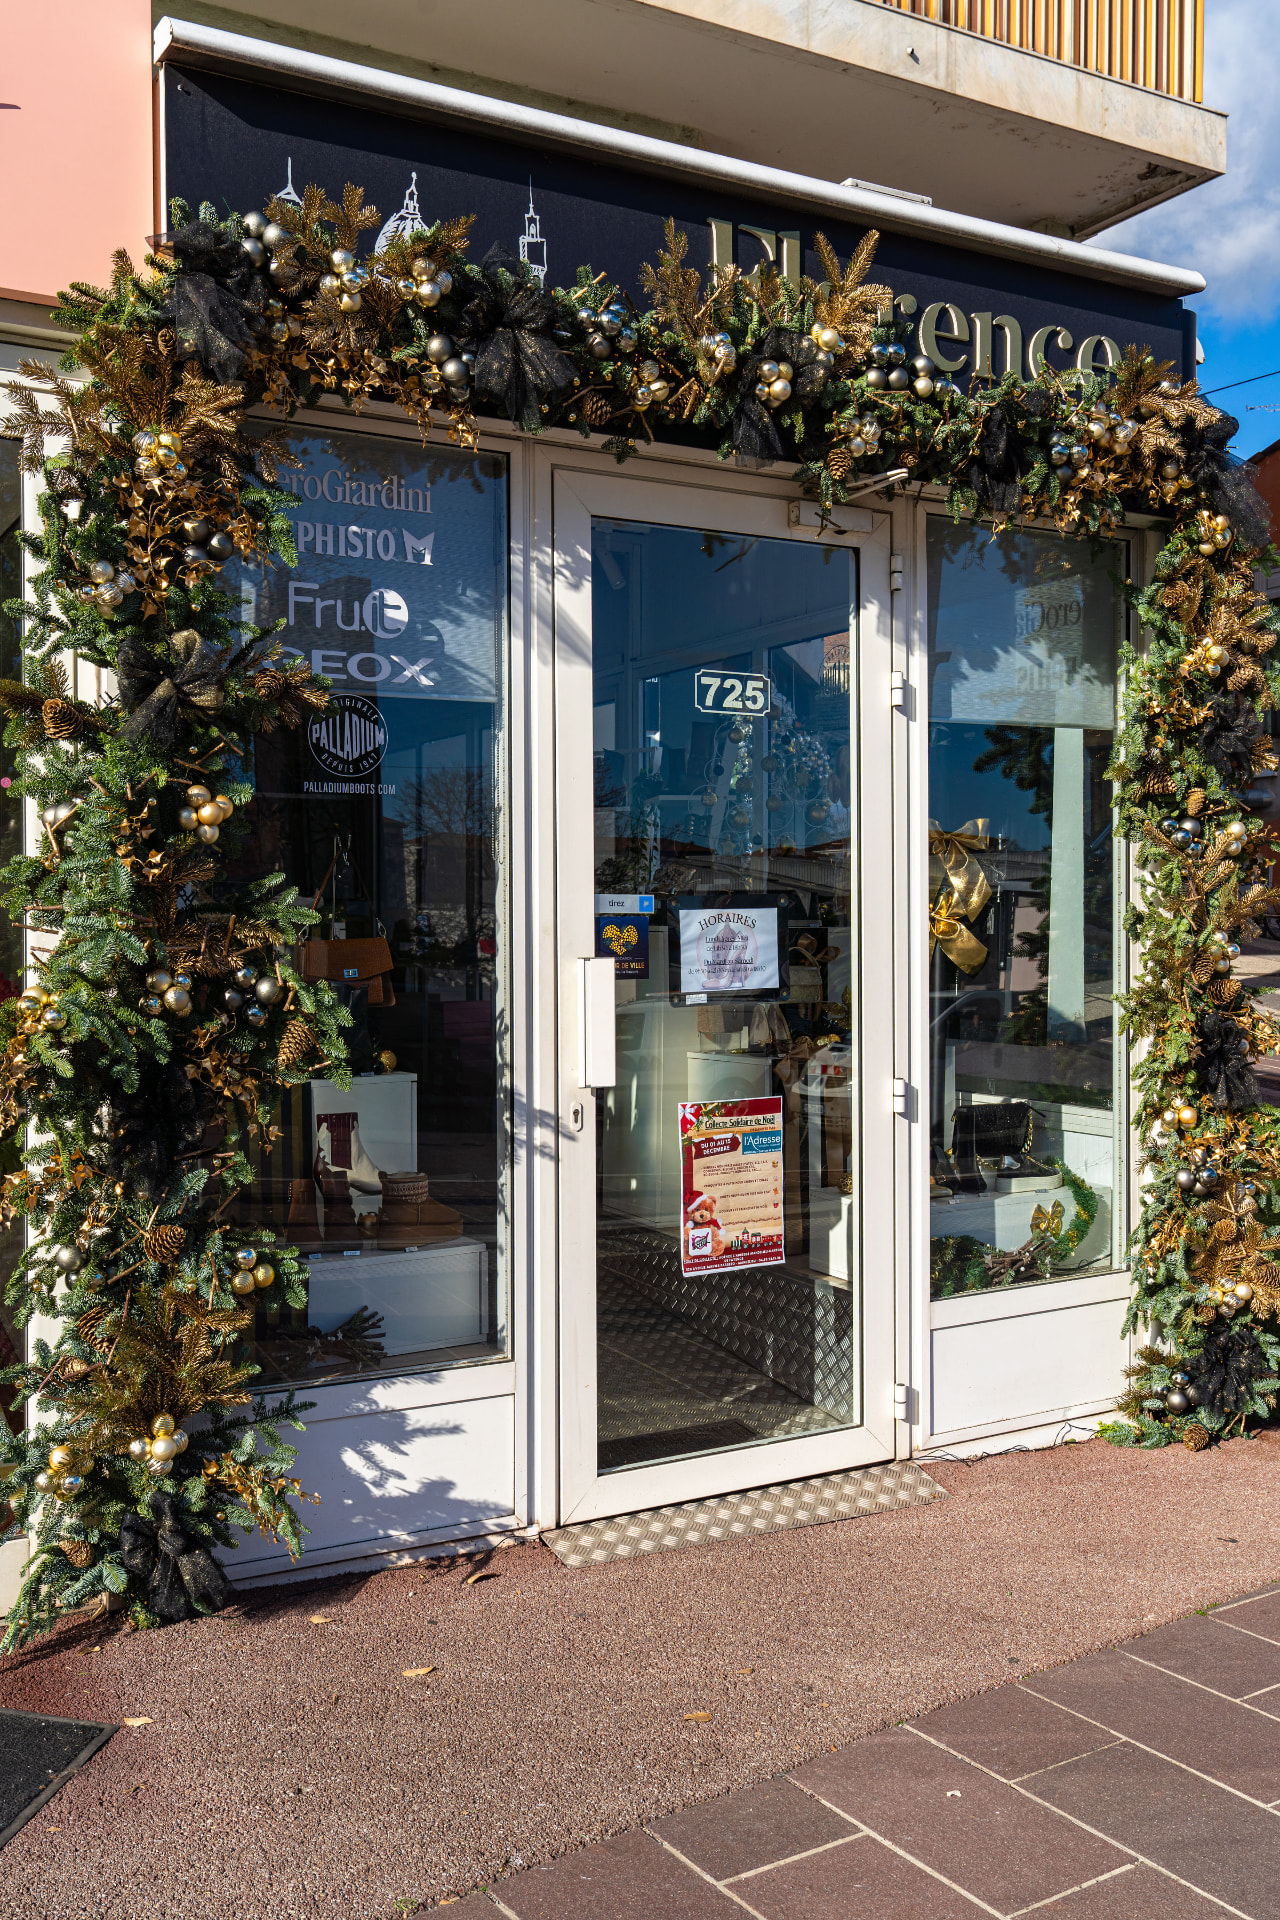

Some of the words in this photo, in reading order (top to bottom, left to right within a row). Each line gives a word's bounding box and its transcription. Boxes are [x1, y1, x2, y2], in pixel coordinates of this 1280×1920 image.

[706, 217, 1122, 386] Flrence
[291, 520, 396, 562] PHISTO
[700, 676, 766, 710] 725
[311, 711, 385, 762] PALLADIUM
[321, 753, 354, 773] DEPUIS
[359, 752, 378, 770] 1947
[608, 899, 625, 907] tirez
[698, 913, 757, 931] HORAIRES
[716, 1139, 725, 1147] AU
[744, 1135, 781, 1150] l'Adresse
